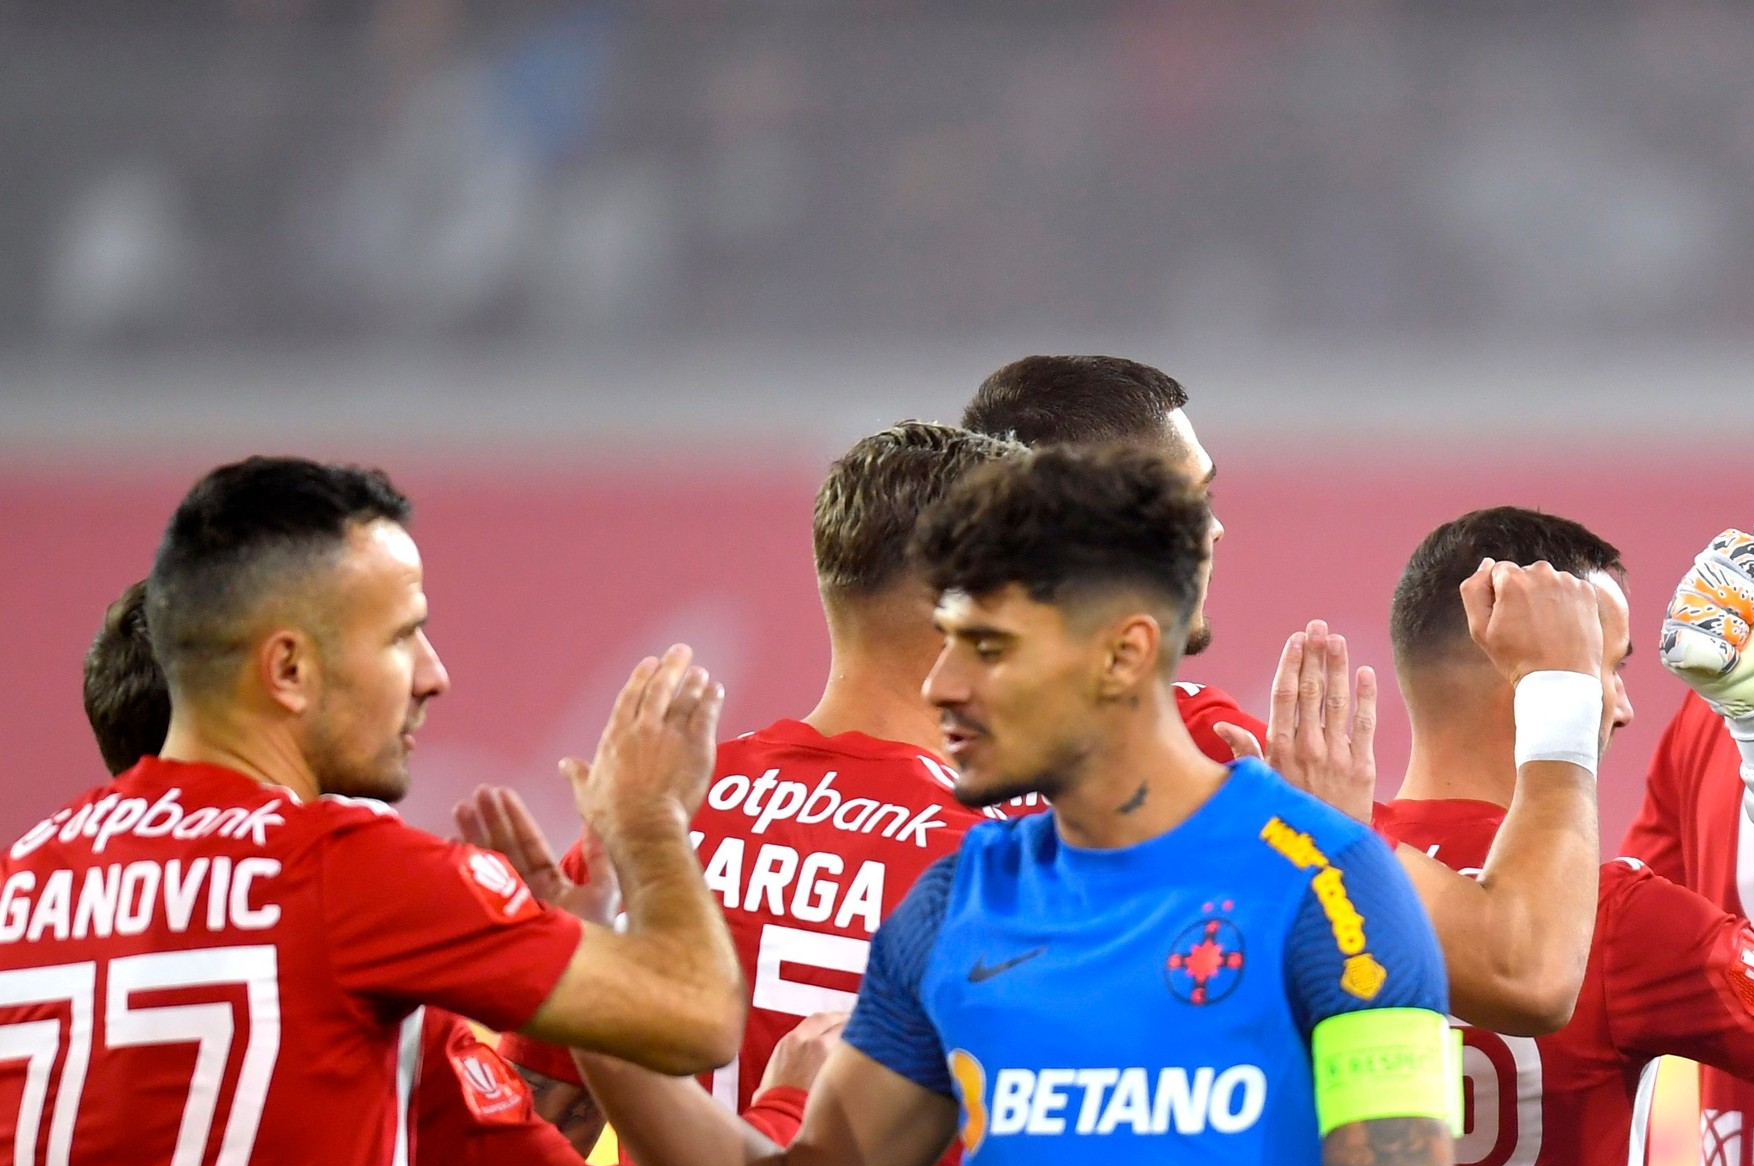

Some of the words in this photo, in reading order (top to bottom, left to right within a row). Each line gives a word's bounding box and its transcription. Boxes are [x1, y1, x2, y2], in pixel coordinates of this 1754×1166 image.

[708, 769, 947, 847] otpbank
[0, 856, 282, 944] GANOVIC
[689, 830, 886, 933] ARGA
[990, 1064, 1267, 1135] BETANO
